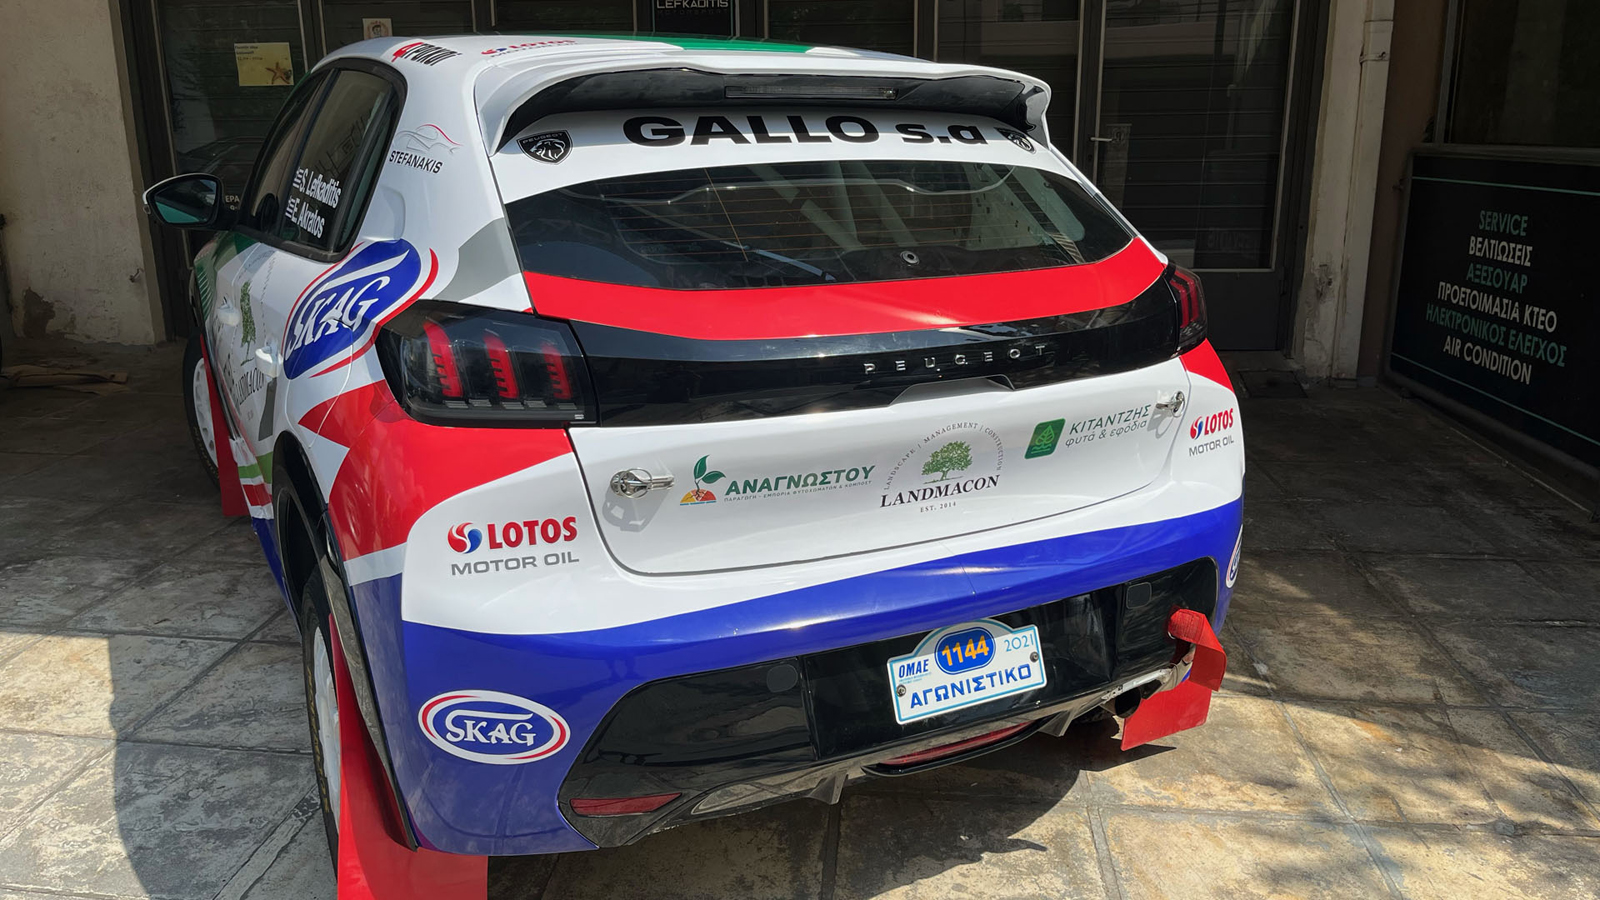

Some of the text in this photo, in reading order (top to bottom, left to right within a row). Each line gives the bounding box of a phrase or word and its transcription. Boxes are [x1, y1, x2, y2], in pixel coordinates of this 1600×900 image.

[656, 0, 729, 9] LEFKADITIS
[622, 115, 880, 147] GALLO
[389, 150, 443, 174] STEFANAKIS
[305, 171, 342, 209] Lefkaditis
[297, 201, 325, 239] Akratos
[1479, 210, 1528, 236] SERVICE
[1468, 235, 1533, 267] ΒΕΛΤΙΩΣΕΙΣ
[1466, 263, 1528, 294] ΑΞΕΣΟΥΑΡ
[285, 249, 410, 361] SKAG
[1438, 281, 1557, 333] ΠΡΟΕΤΟΙΜΑΣΙΑ ΚΤΕΟ
[1426, 303, 1567, 367] ΗΛΕΚΤΡΟΝΙΚΟΣ ΕΛΕΓΧΟΣ
[863, 345, 1045, 374] PEUGEOT
[1443, 335, 1532, 385] AIR CONDITION
[1065, 431, 1096, 448] φυτά
[1109, 419, 1148, 438] εφόδια
[1069, 404, 1152, 435] ΚΙΤΑΝΤΖΗΣ
[1203, 407, 1234, 436] LOTOS
[884, 448, 916, 491] LANDSCAPE
[923, 421, 978, 443] MANAGEMENT
[1188, 435, 1235, 457] MOTOR OIL
[725, 465, 876, 496] ΑΝΑΓΝΩΣΤΟΥ
[880, 474, 1000, 508] LANDMACON
[920, 501, 956, 513] EST. 2014
[487, 516, 578, 550] LOTOS
[451, 551, 580, 576] MOTOR OIL
[941, 635, 990, 667] 1144
[1004, 633, 1035, 652] 2021
[910, 663, 1032, 709] ΑΓΩΝΙΣΤΙΚΟ
[444, 709, 537, 746] SKAG
